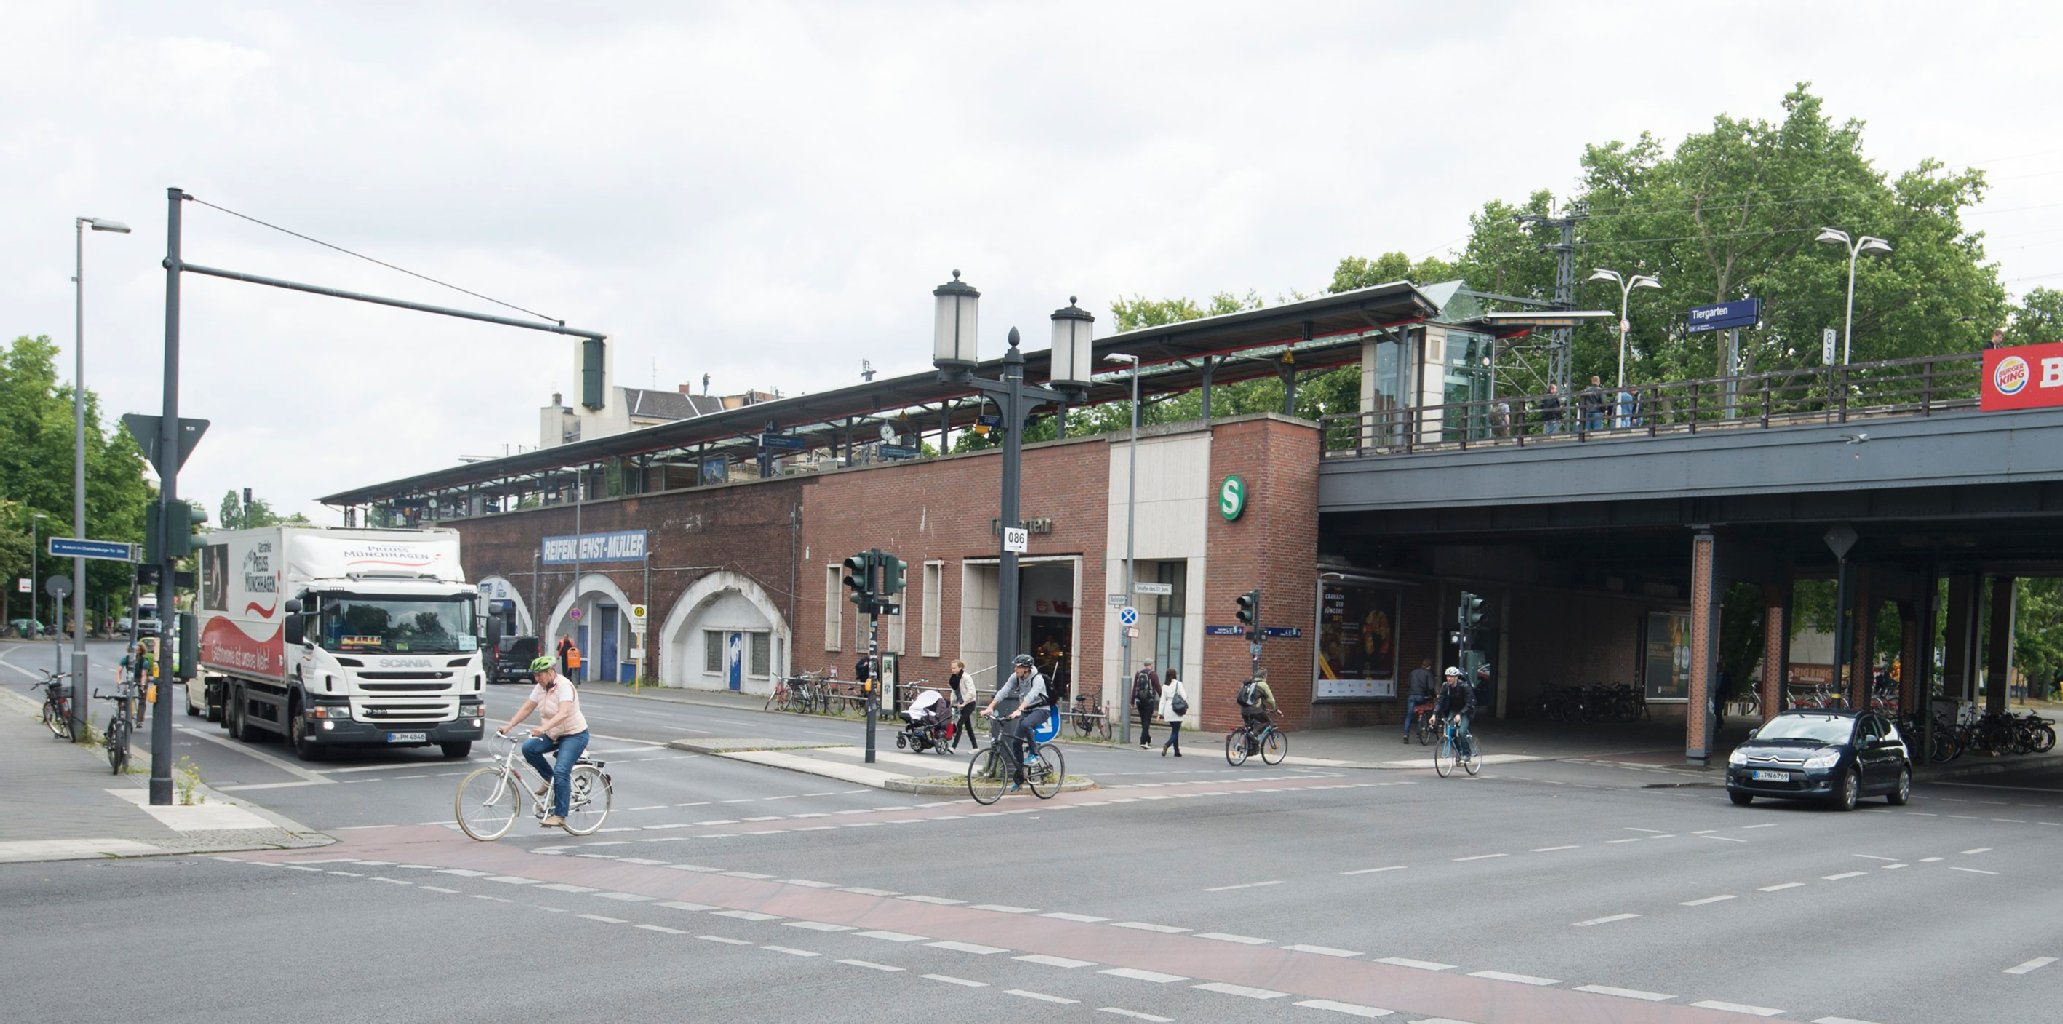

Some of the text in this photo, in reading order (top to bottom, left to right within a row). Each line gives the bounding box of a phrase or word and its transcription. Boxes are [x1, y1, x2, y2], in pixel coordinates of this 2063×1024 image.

[1692, 306, 1728, 320] Tiergarten
[1827, 332, 1832, 344] 8
[1826, 347, 1831, 360] 3
[1999, 362, 2024, 377] BURGER
[1999, 369, 2025, 387] KING
[1222, 479, 1240, 514] S
[1008, 531, 1025, 544] 086
[379, 659, 432, 668] SCANIA
[1794, 667, 1832, 678] BIG KING
